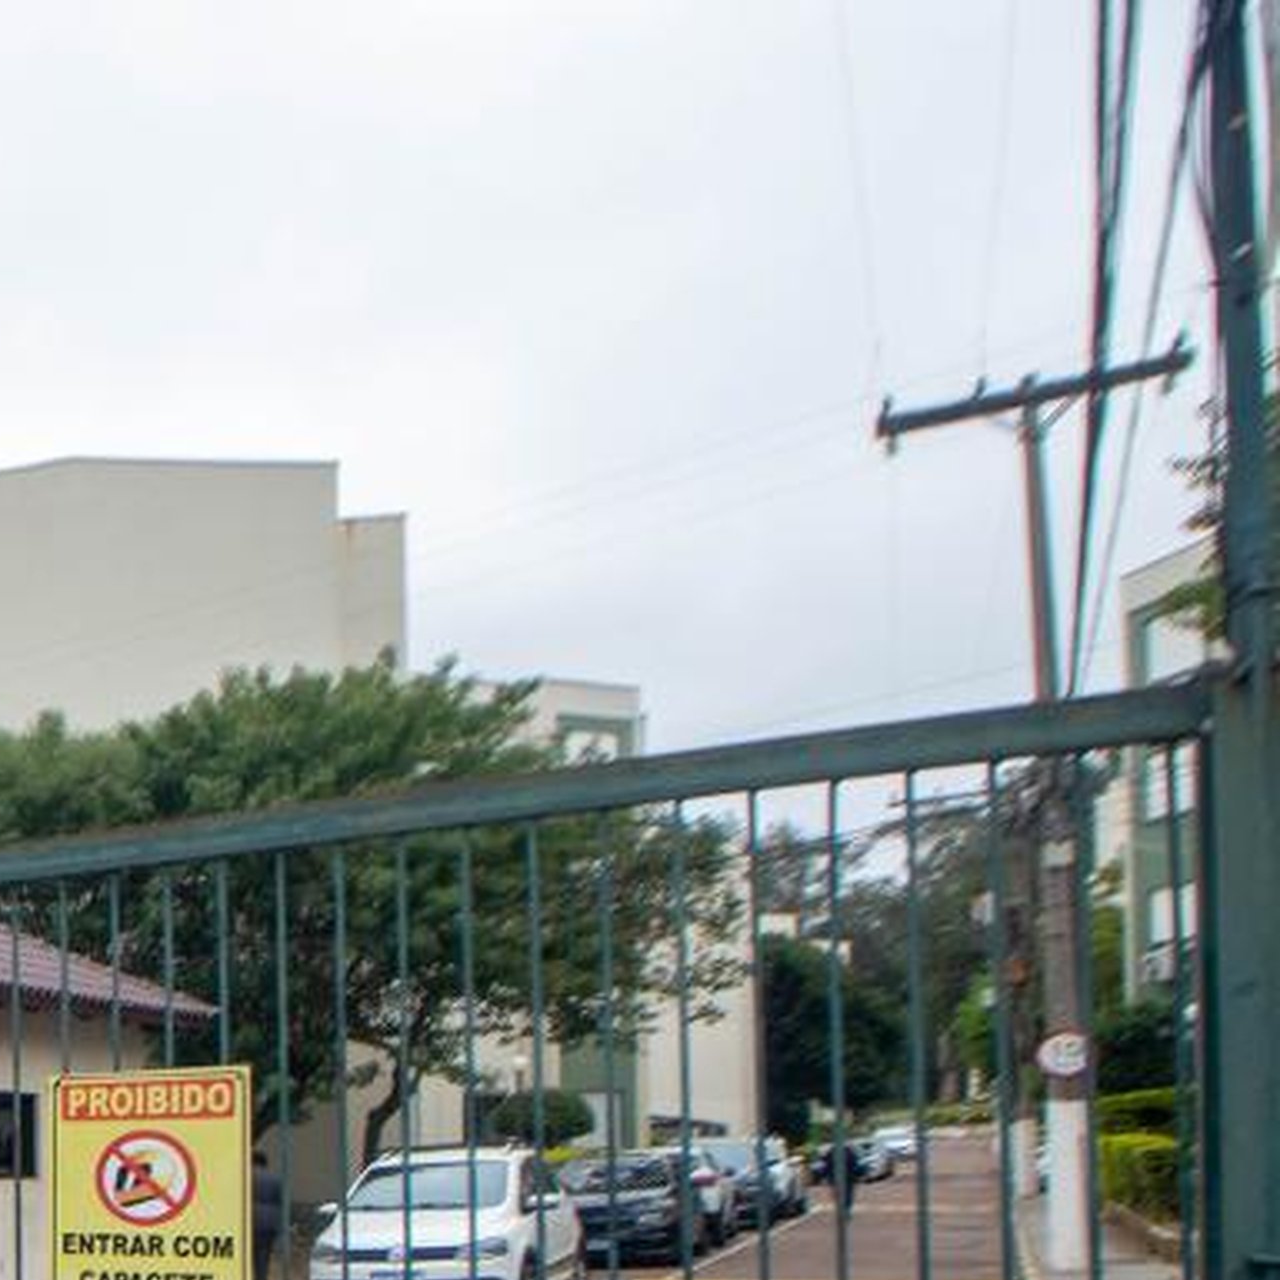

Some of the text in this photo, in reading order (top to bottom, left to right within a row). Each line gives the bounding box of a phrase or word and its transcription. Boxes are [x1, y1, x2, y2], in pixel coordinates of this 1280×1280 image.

[66, 1082, 232, 1118] PROIBIDO
[62, 1233, 235, 1259] ENTRAR COM
